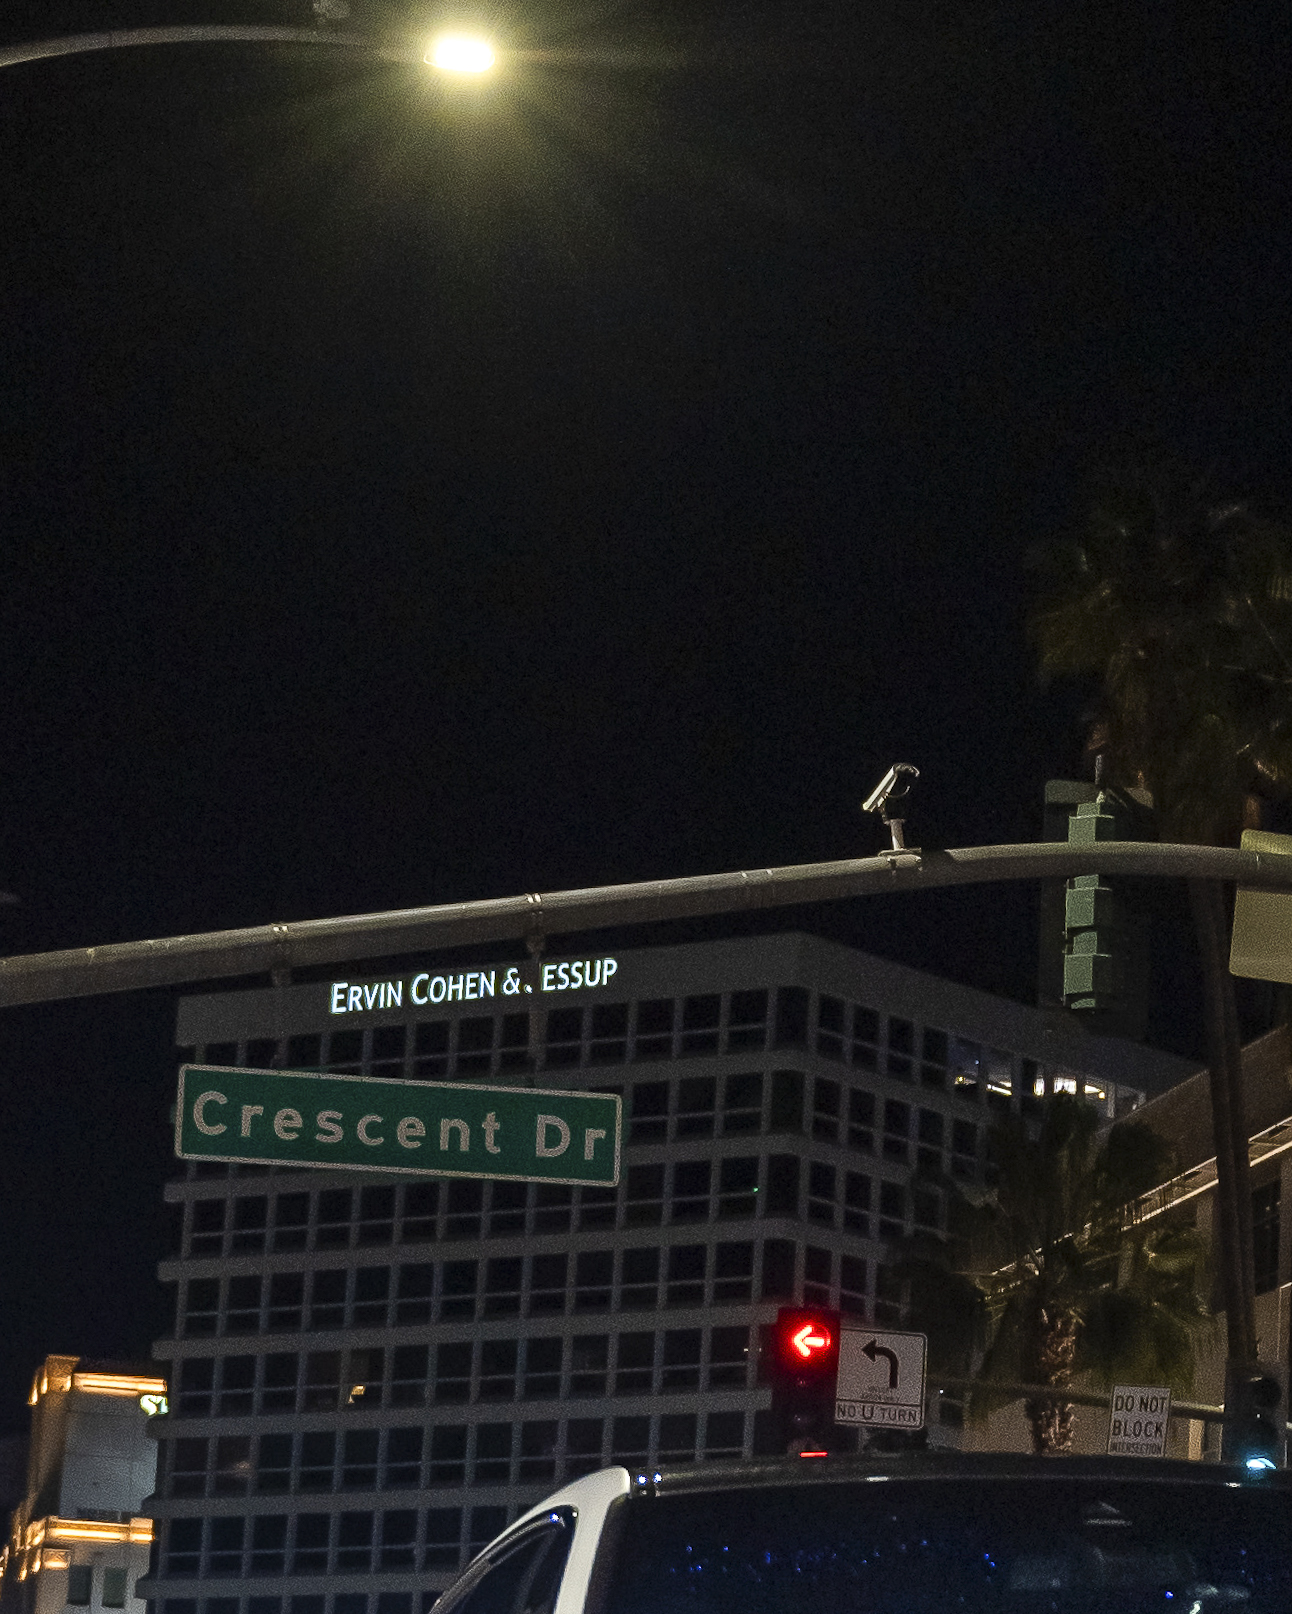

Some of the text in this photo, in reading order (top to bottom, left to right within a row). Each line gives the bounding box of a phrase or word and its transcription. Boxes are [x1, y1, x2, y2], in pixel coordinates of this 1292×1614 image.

[502, 968, 520, 995] &
[523, 957, 618, 994] ESSUP
[192, 1090, 607, 1161] Crescent Dr
[837, 1404, 917, 1421] NO U TURN
[1115, 1395, 1167, 1413] DO NOT
[1112, 1420, 1164, 1438] BLOCK
